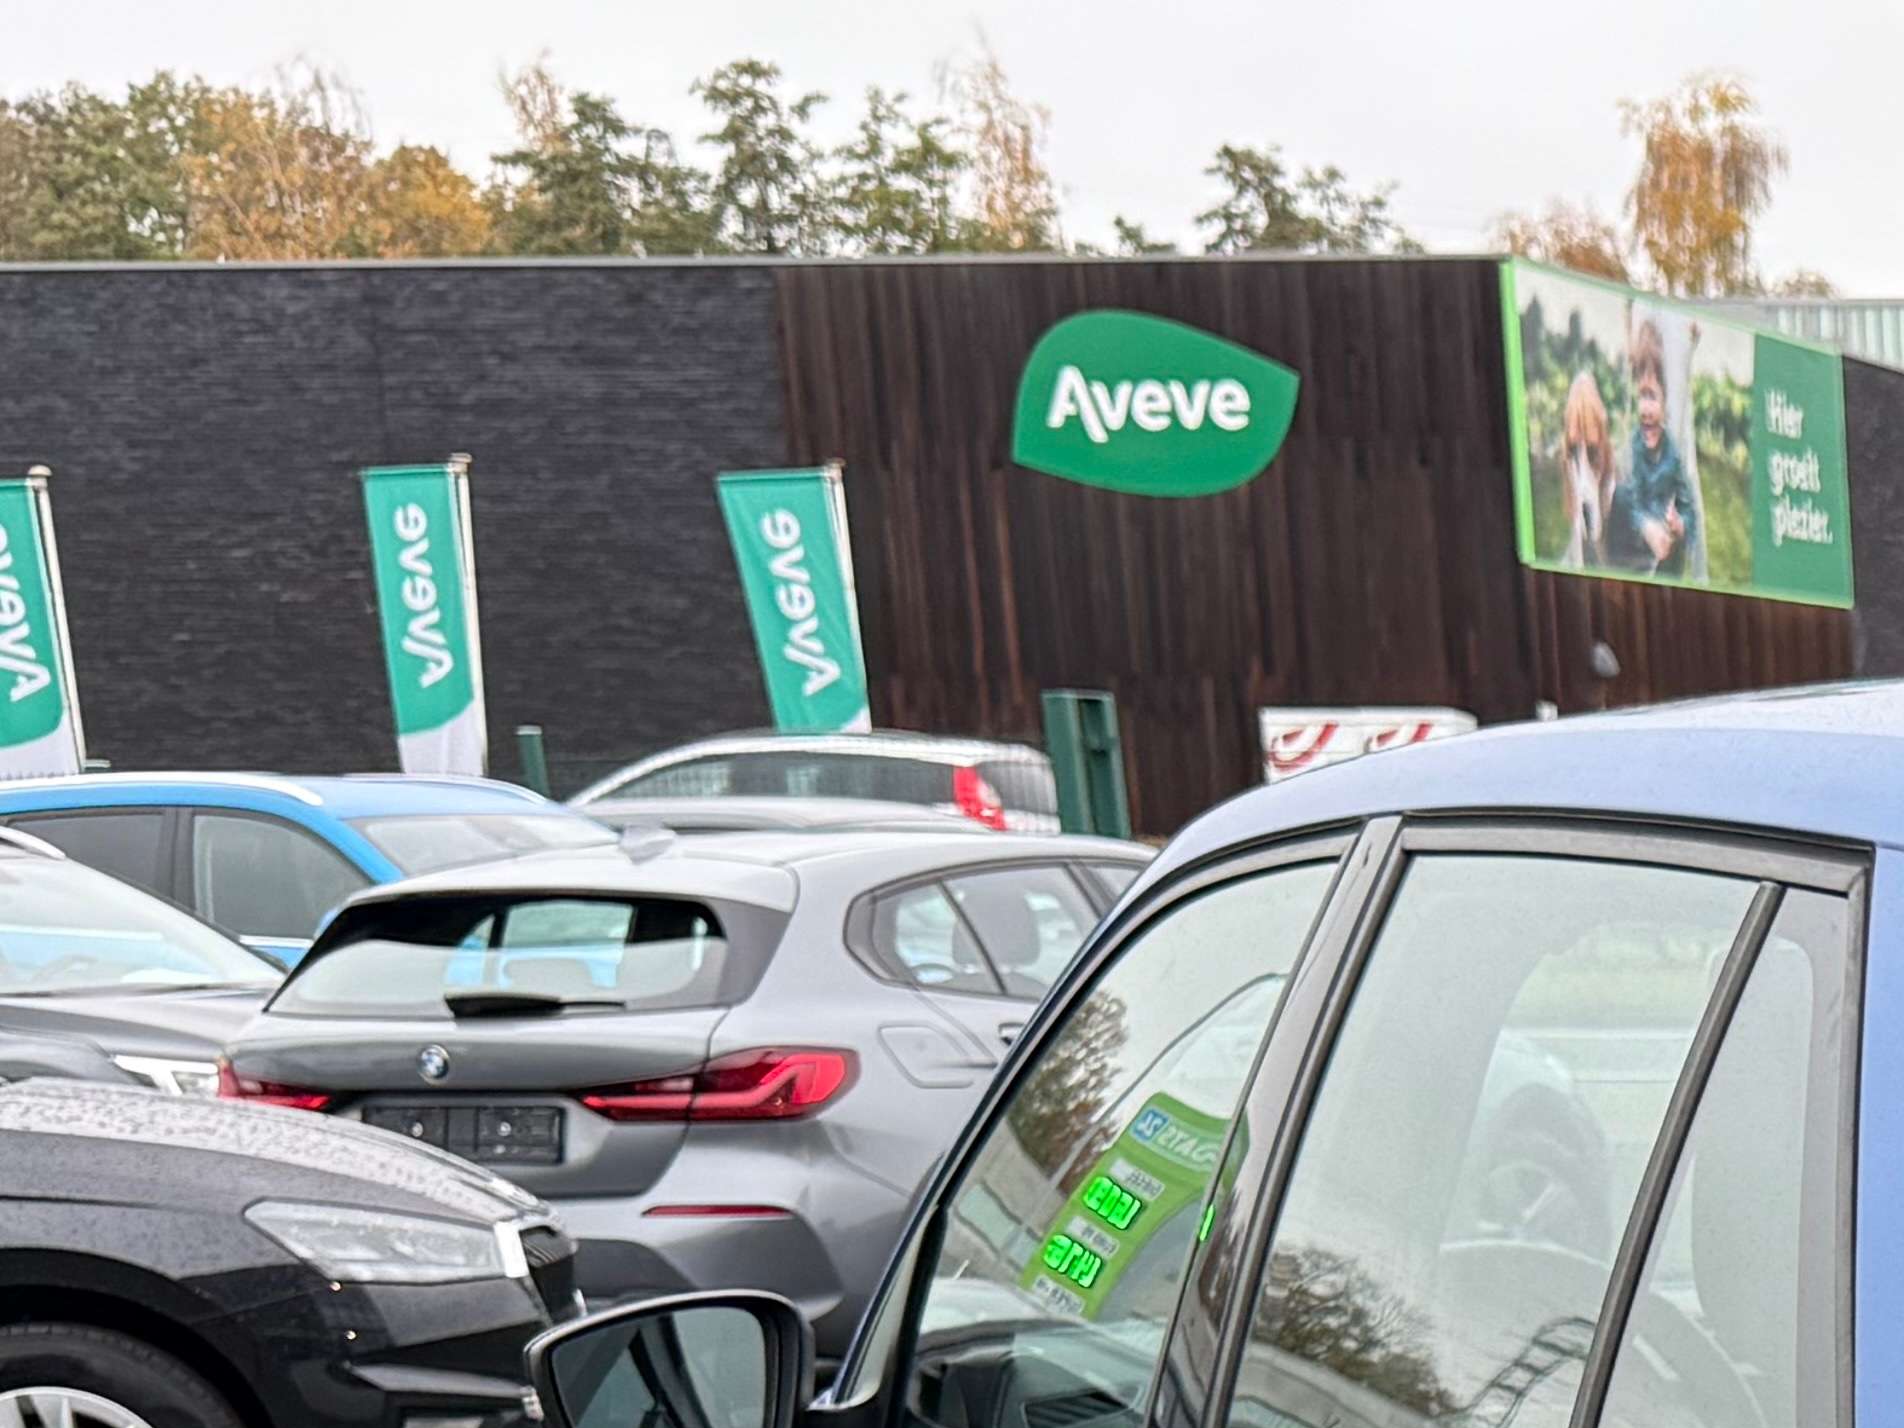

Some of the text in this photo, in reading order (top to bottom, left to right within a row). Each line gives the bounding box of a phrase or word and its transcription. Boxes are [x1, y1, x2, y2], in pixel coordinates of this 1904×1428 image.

[1046, 365, 1251, 443] Aveve
[1765, 388, 1804, 440] Hier
[1769, 448, 1822, 496] groeit
[0, 522, 51, 703] Avev
[394, 503, 454, 689] Aveve
[762, 508, 842, 697] Aveve
